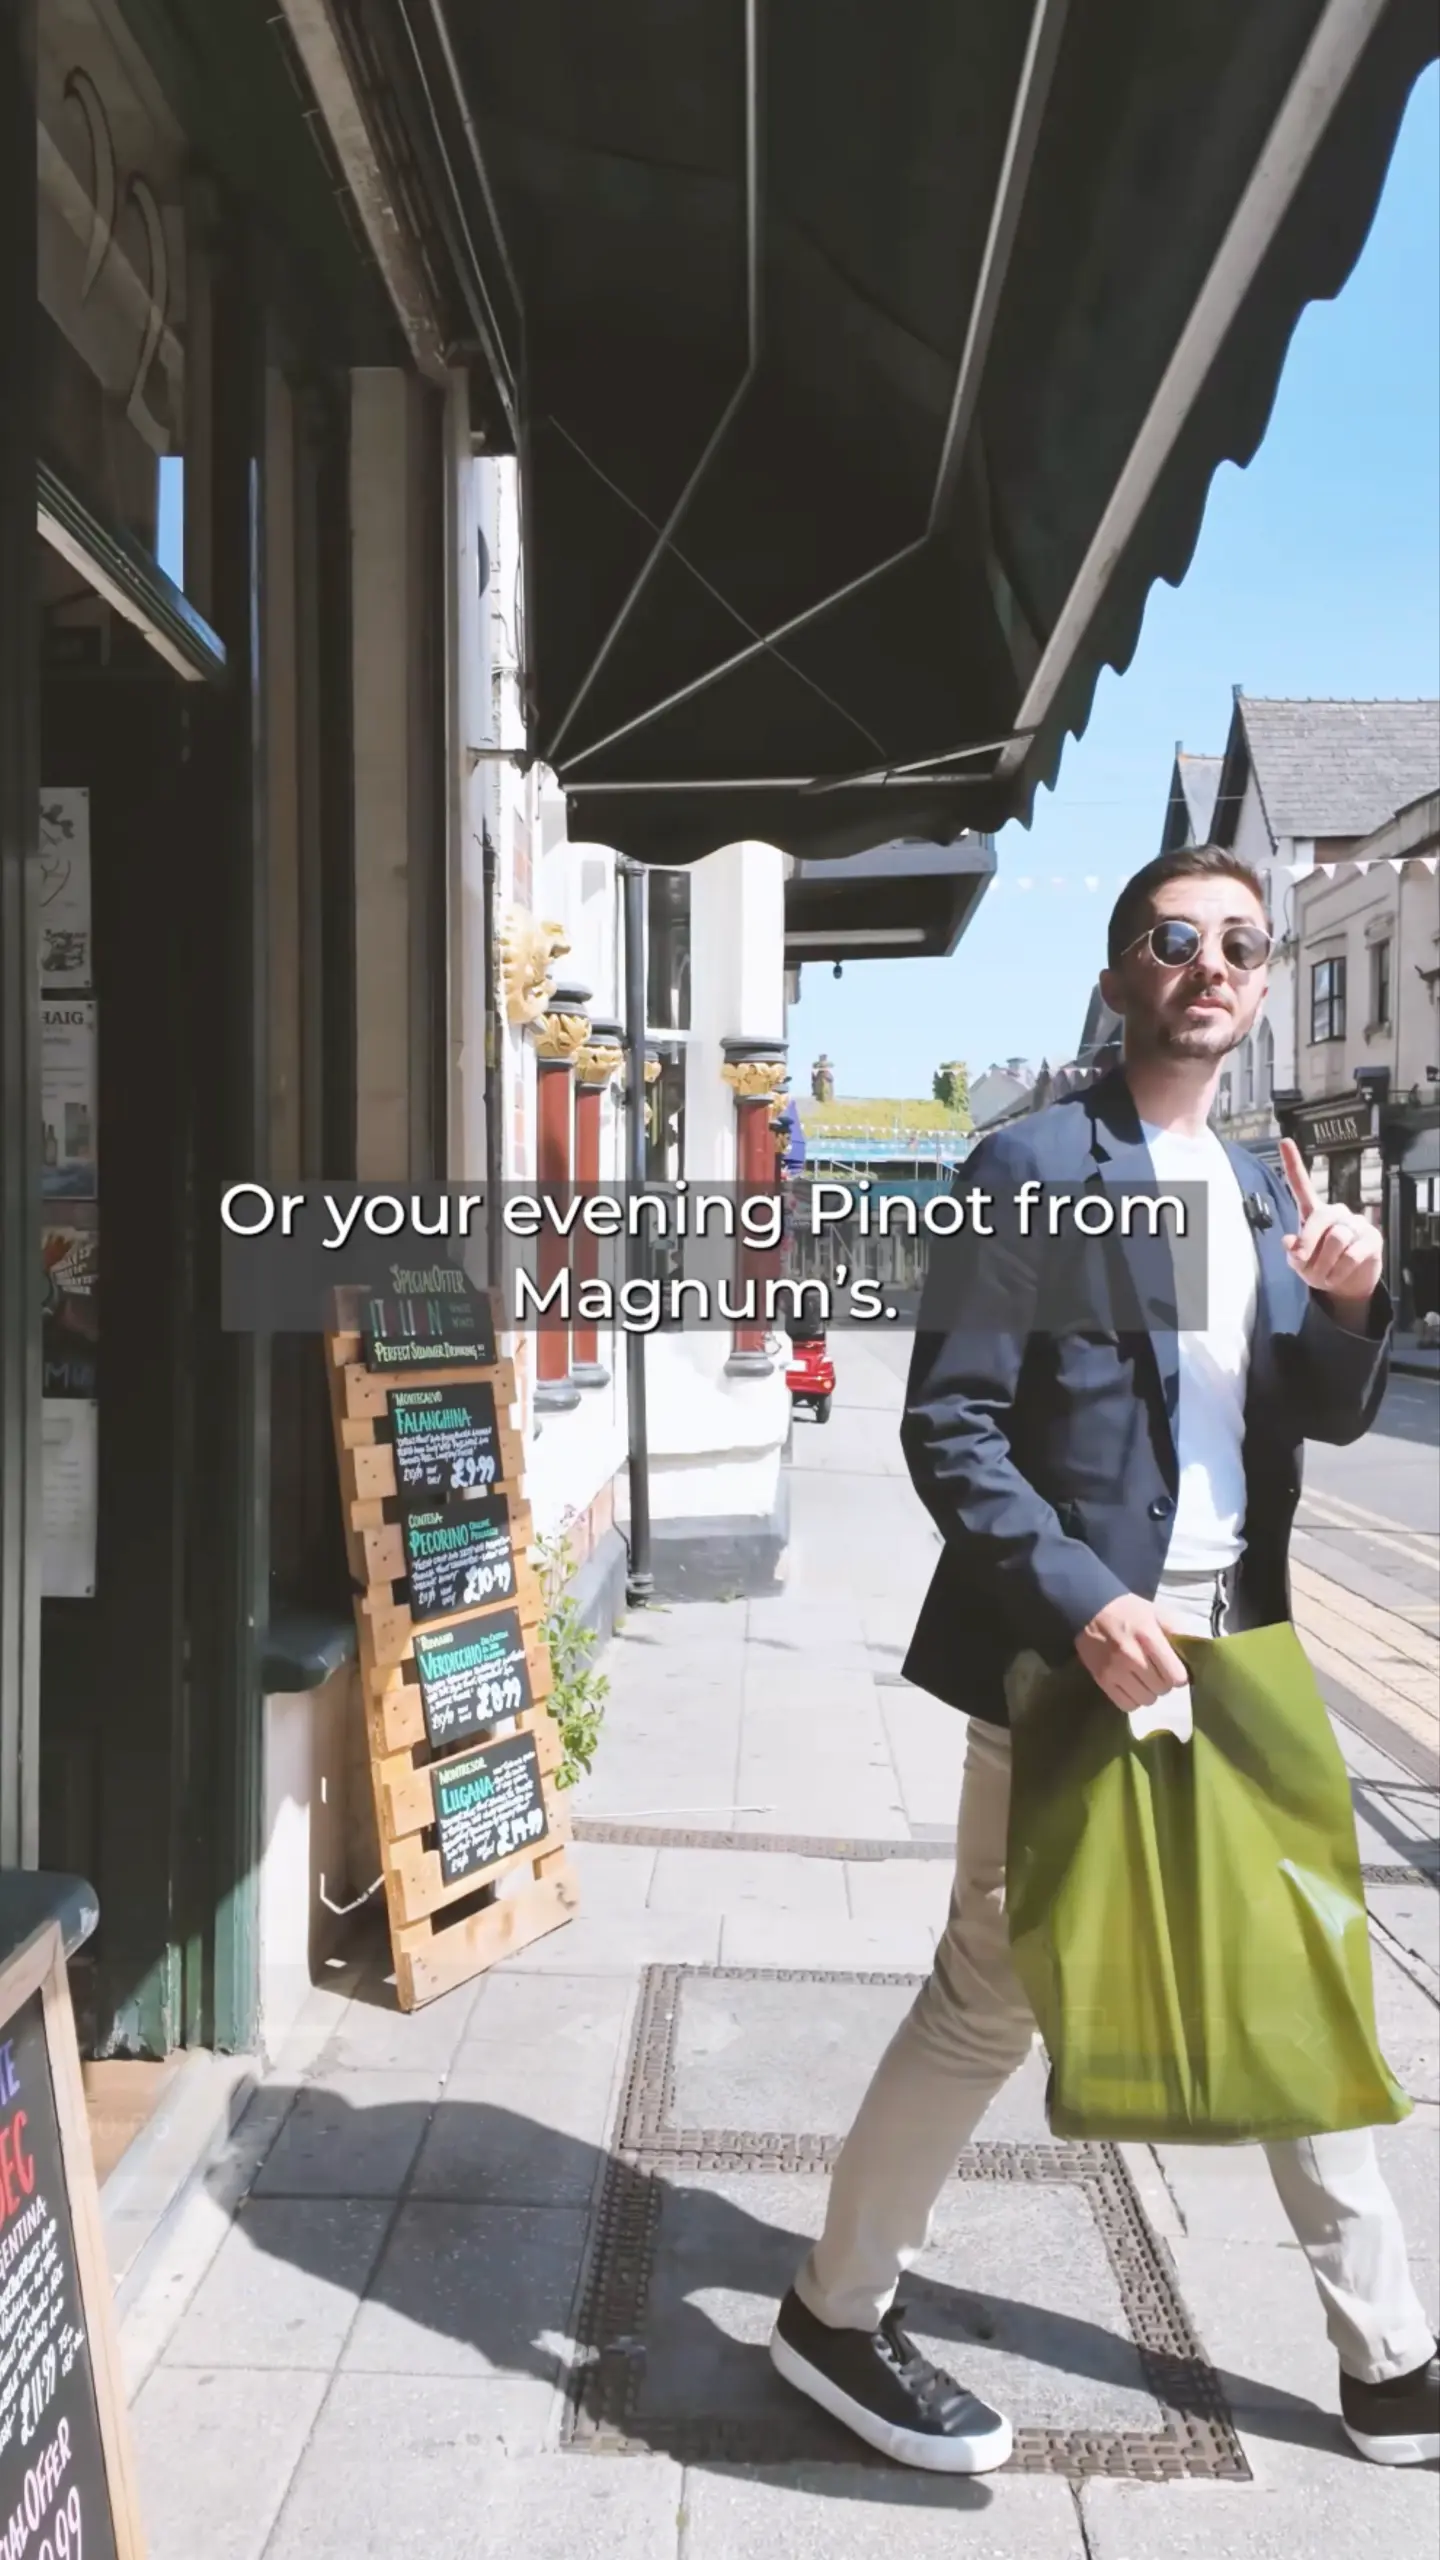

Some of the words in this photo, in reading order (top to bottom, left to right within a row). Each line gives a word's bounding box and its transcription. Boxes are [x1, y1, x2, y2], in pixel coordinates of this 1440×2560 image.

[374, 1341, 410, 1363] PERFECT
[394, 1407, 473, 1435] FALANGHINA
[409, 1524, 469, 1558] PECORINO
[420, 1643, 483, 1681] VERDICCHIO
[441, 1774, 495, 1815] LUGANA
[20, 2342, 57, 2446] £11.99
[24, 2416, 72, 2532] OFFER
